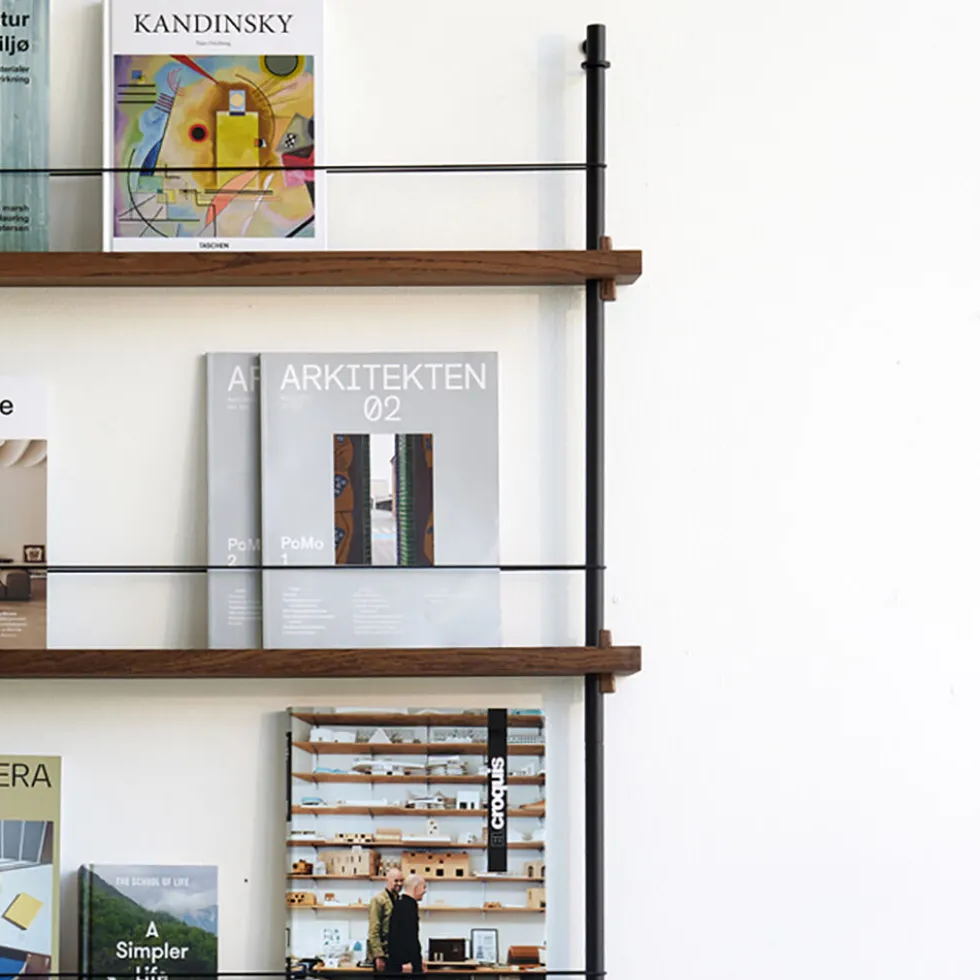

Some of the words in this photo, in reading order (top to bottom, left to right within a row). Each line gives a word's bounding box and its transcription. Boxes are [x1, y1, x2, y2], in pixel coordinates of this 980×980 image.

[134, 14, 293, 34] KANDINSKY
[280, 363, 487, 391] ARKITEKTEN
[364, 395, 402, 422] 02
[280, 536, 324, 550] PoMo
[227, 554, 238, 566] 2
[280, 552, 288, 566] 1
[487, 757, 508, 830] croquis
[116, 877, 130, 886] THE
[132, 877, 160, 886] SCHOOL
[162, 877, 171, 886] OF
[173, 877, 190, 886] LIFE
[146, 920, 158, 938] A
[116, 941, 190, 964] Simpler
